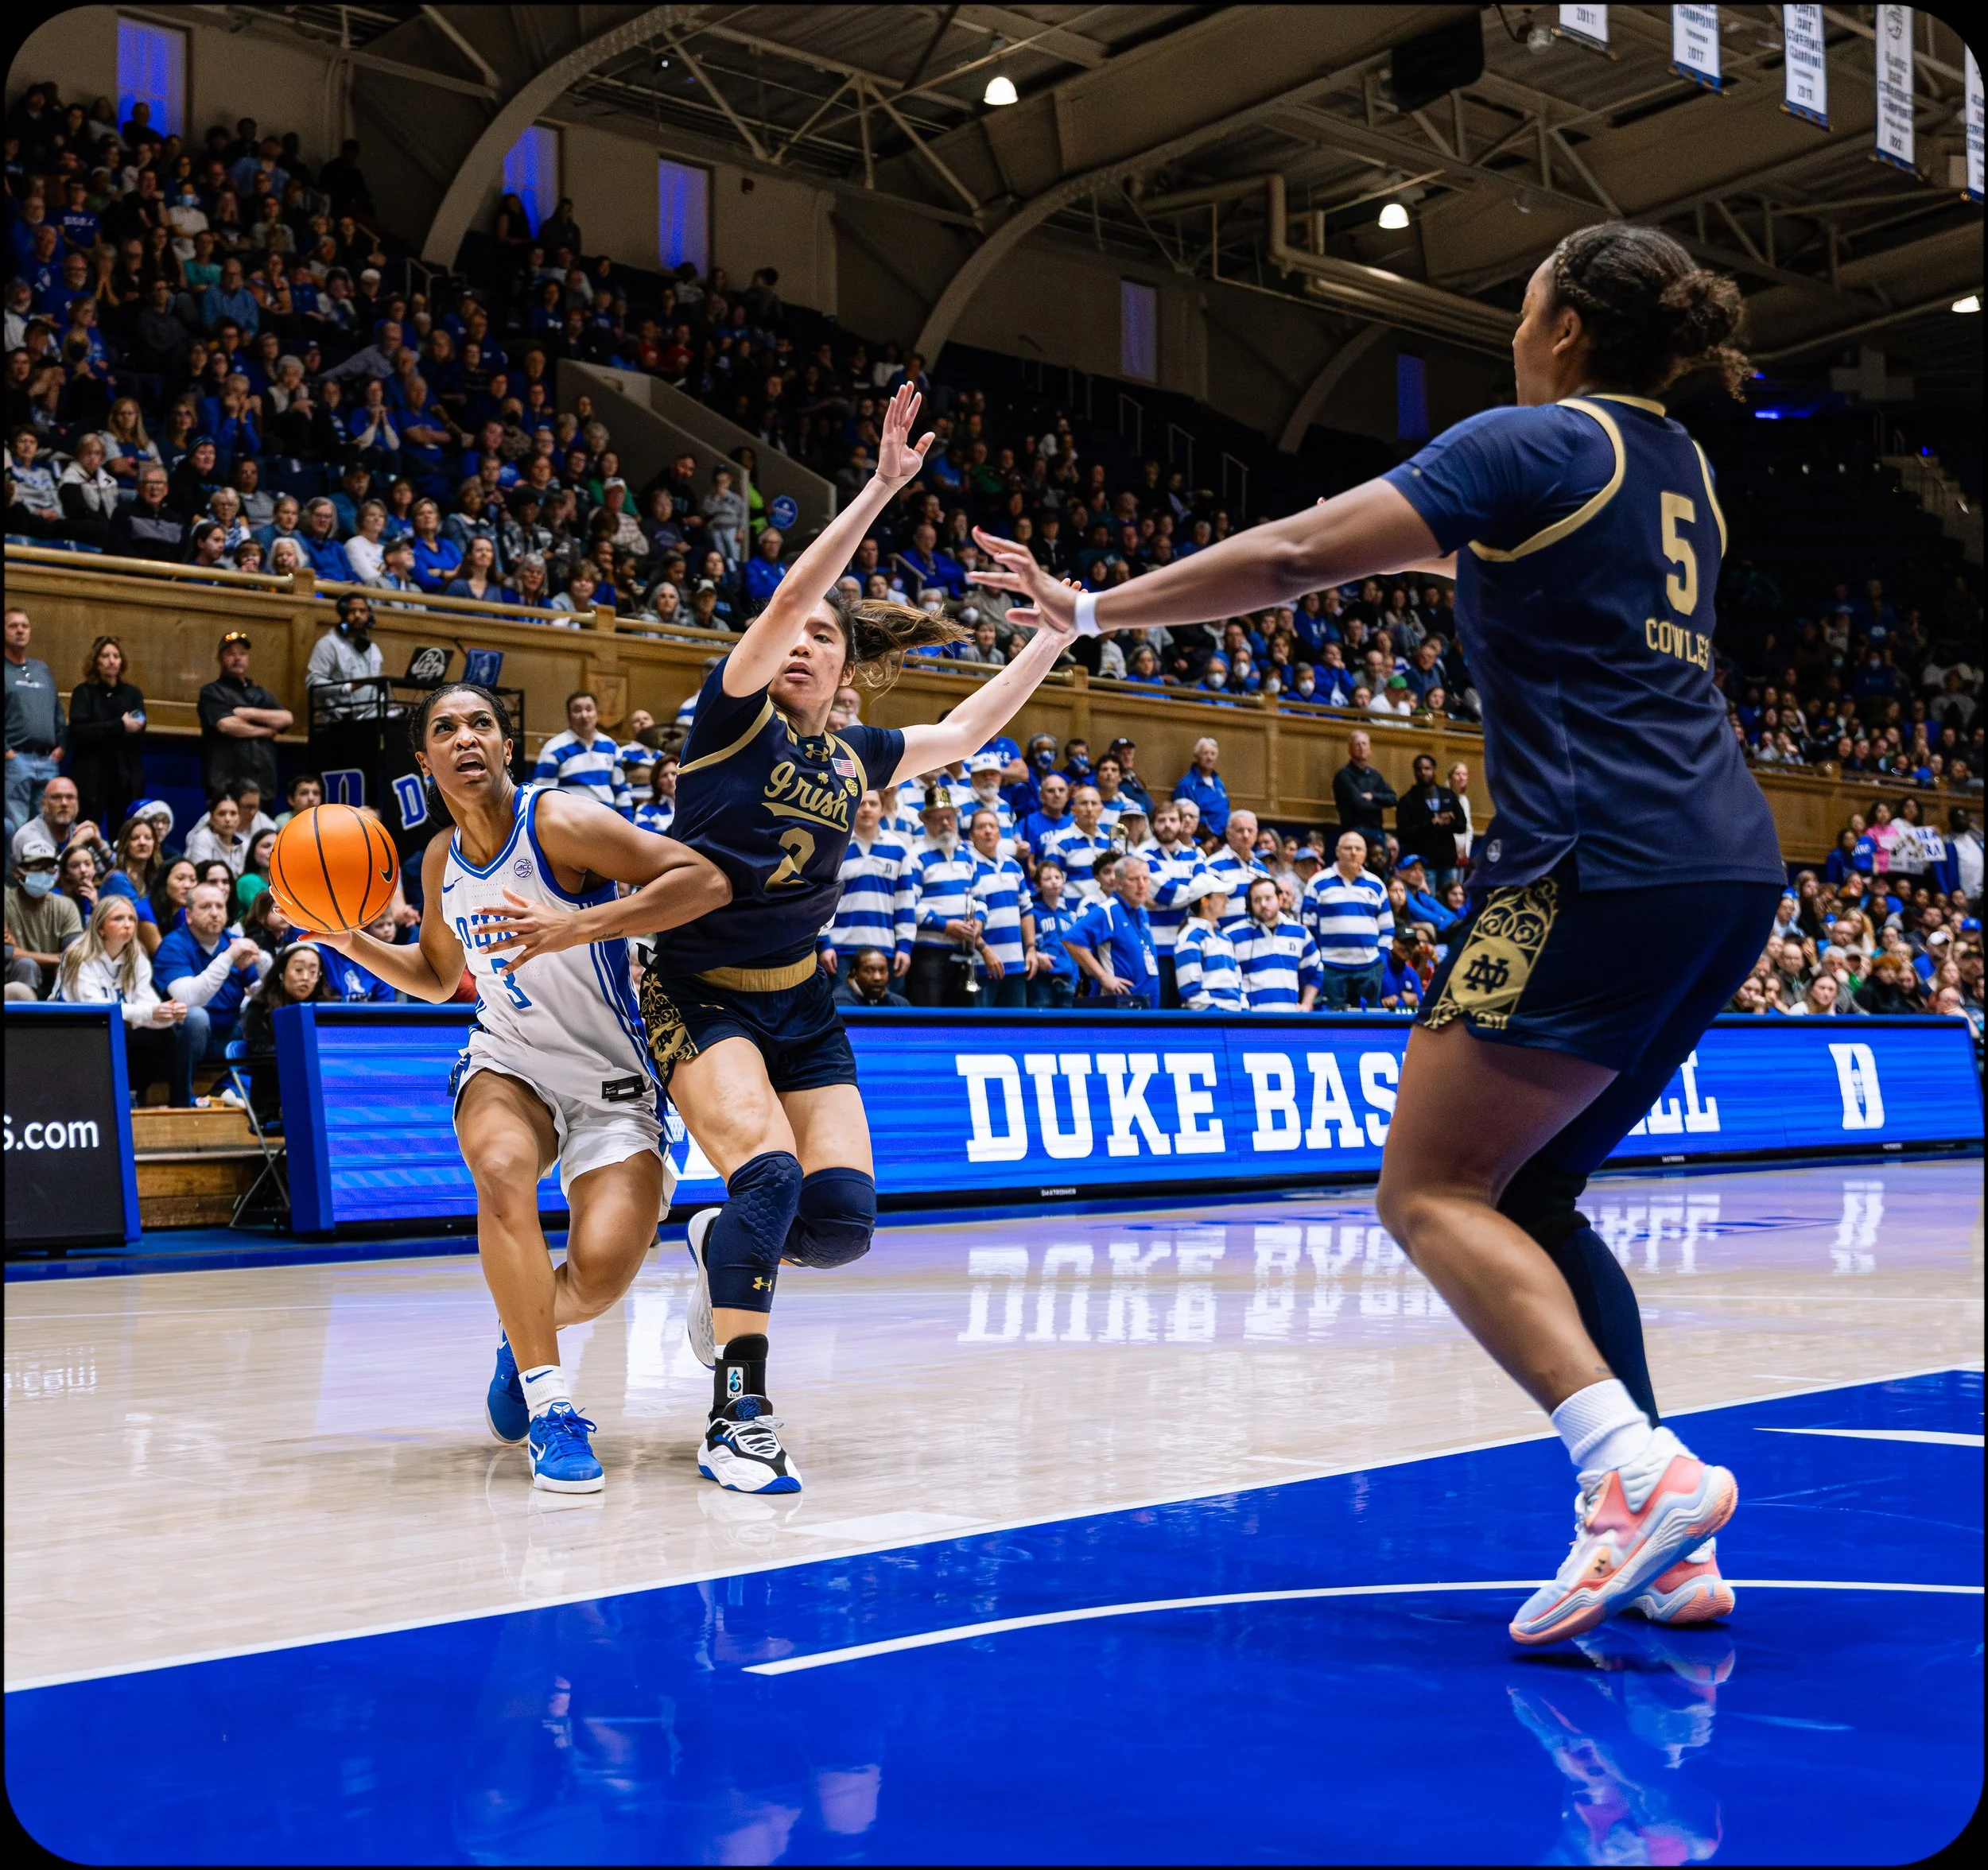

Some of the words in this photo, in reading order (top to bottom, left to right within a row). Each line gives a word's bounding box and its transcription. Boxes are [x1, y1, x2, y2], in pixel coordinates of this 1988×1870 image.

[1660, 491, 1699, 616] 5
[764, 761, 849, 828] Irish
[763, 827, 816, 892] 2
[490, 957, 533, 1010] 3
[955, 1053, 1226, 1162] DUKE
[1829, 1042, 1885, 1131] D
